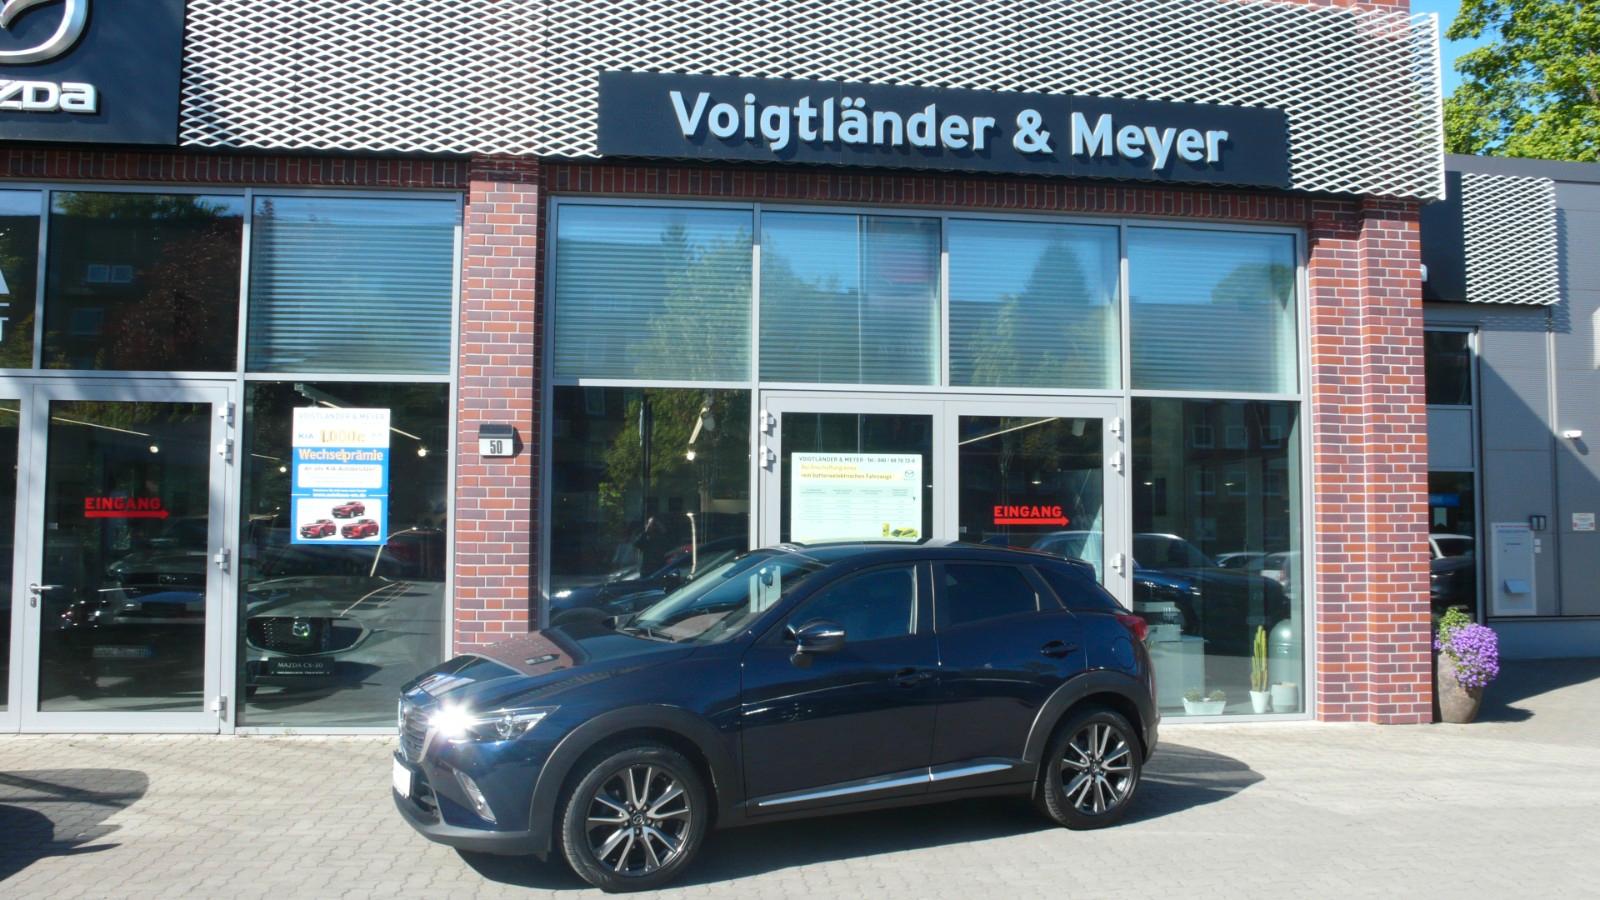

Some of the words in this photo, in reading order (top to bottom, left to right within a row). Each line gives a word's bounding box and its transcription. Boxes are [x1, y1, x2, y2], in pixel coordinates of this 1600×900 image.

[669, 91, 996, 151] Voigtländer
[1012, 108, 1053, 153] &
[1071, 111, 1229, 170] Meyer
[490, 440, 502, 454] 50
[298, 448, 384, 462] Wechselprämie
[85, 497, 162, 510] EINGANG
[993, 505, 1062, 517] EINGANG
